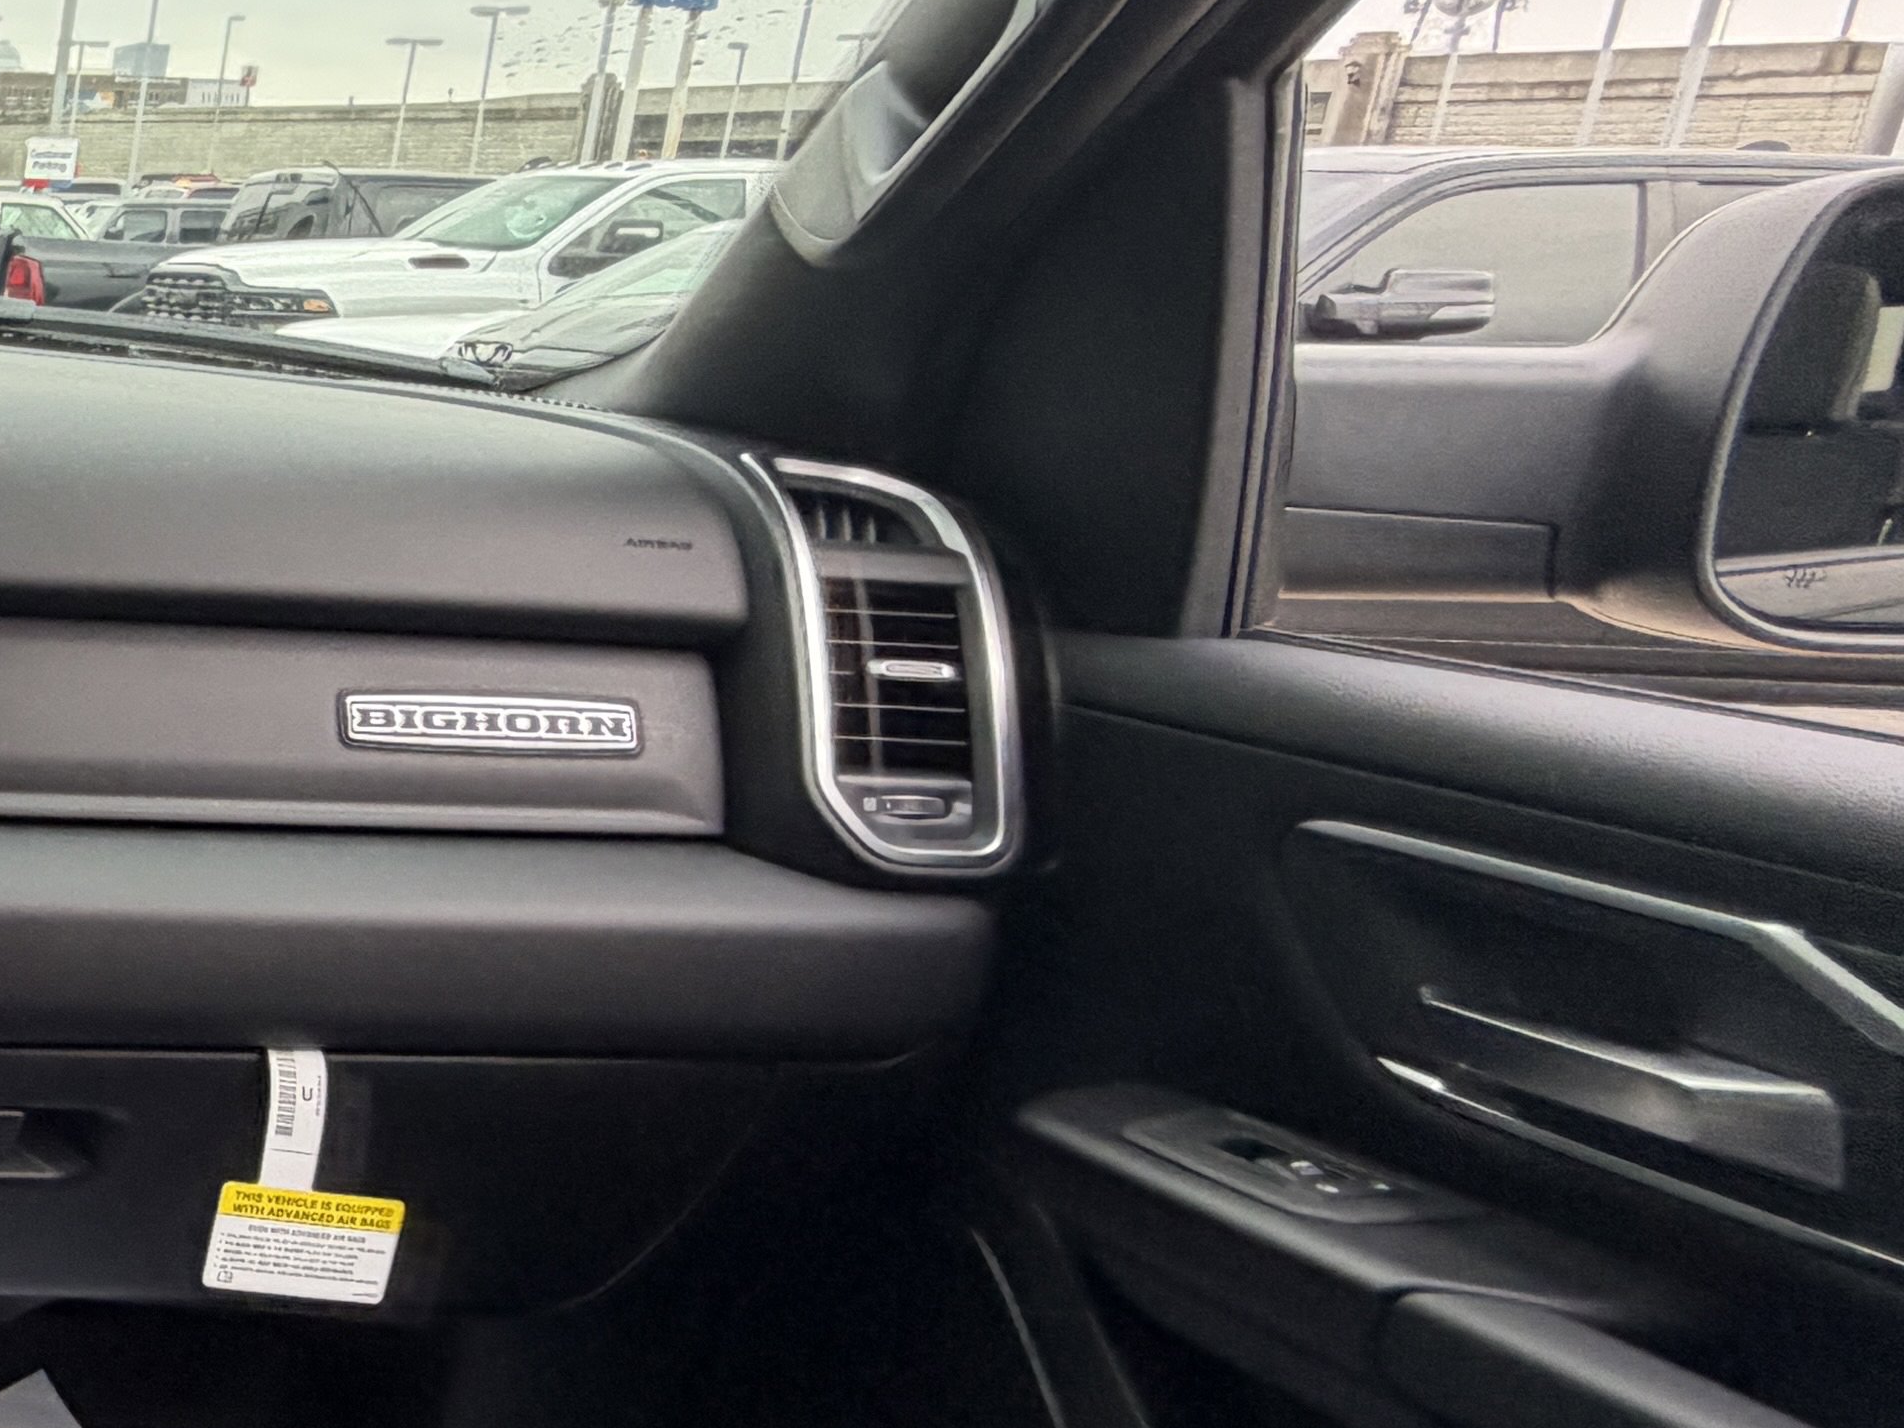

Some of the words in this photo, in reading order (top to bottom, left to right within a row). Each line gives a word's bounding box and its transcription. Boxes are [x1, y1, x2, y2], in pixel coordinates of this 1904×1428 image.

[232, 1203, 265, 1216] WITH
[267, 1205, 335, 1223] ADVANCED
[336, 1215, 358, 1227] AIR
[359, 1217, 392, 1230] BAGS
[235, 1190, 262, 1203] THIS
[267, 1193, 318, 1210] VEHICLE
[321, 1200, 332, 1211] IS
[335, 1202, 396, 1218] EQUIPPED
